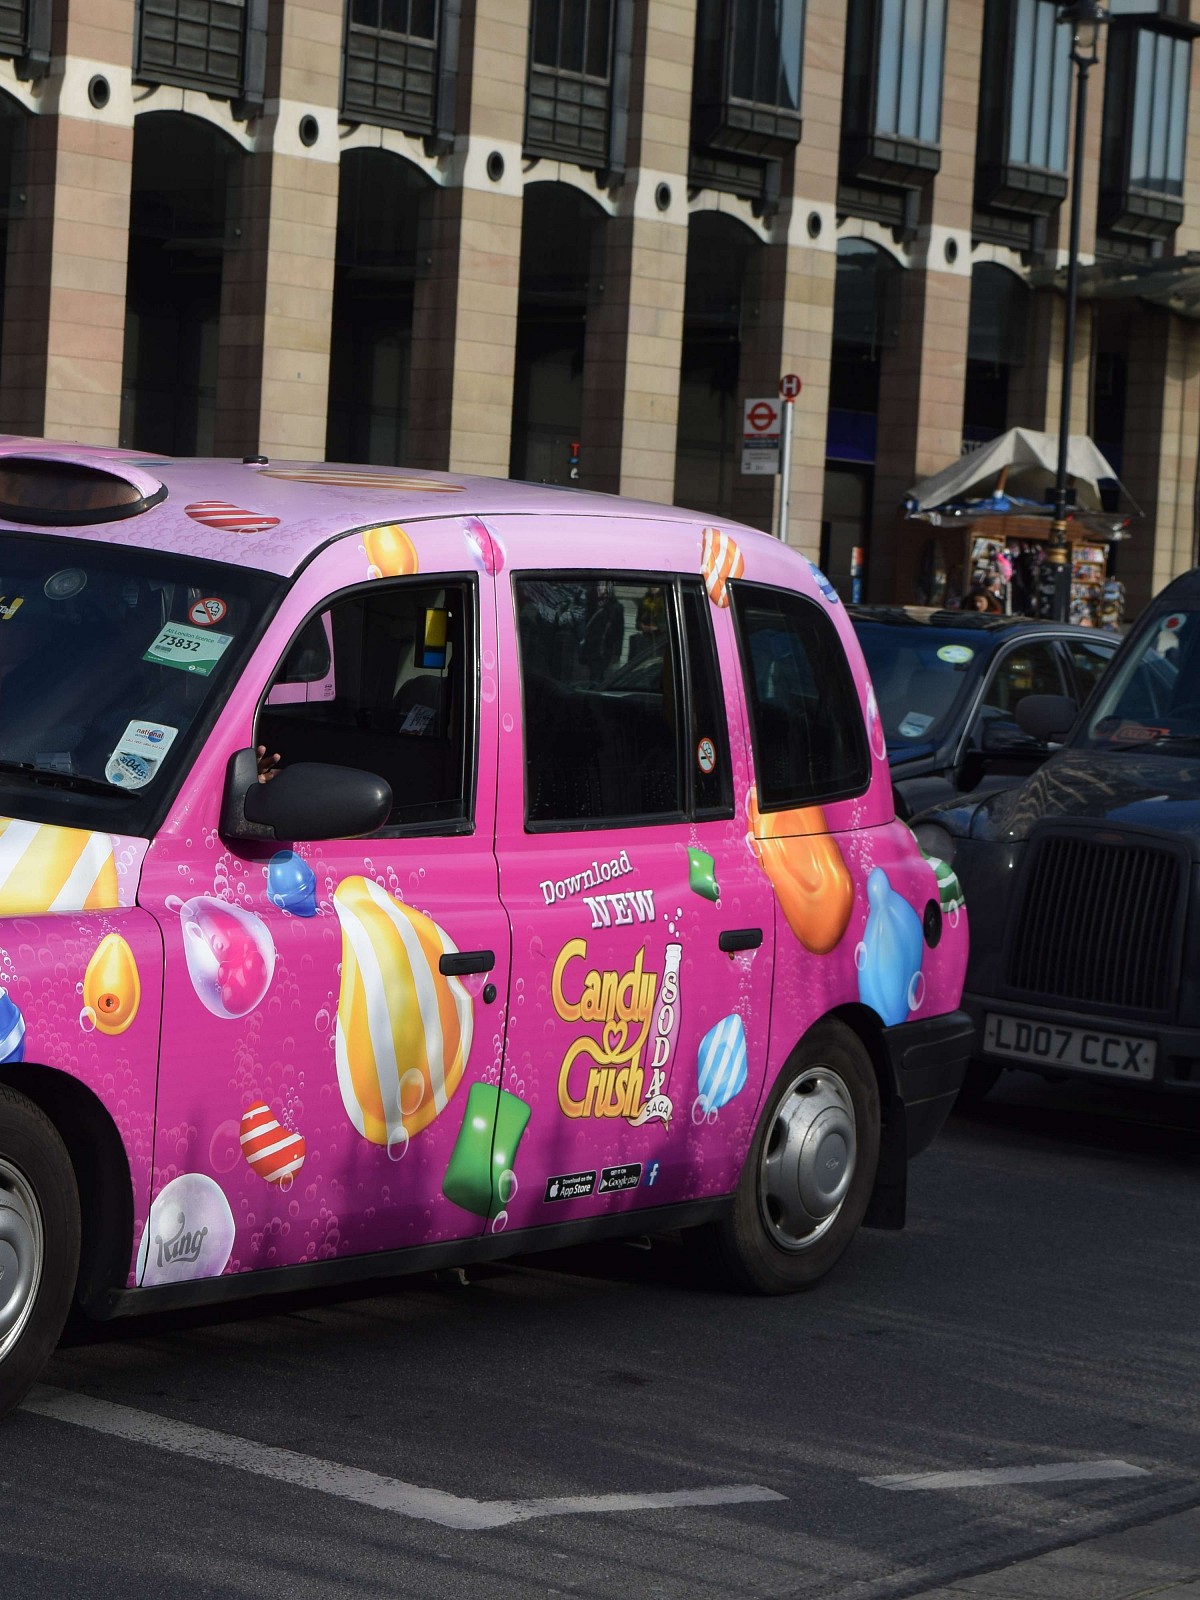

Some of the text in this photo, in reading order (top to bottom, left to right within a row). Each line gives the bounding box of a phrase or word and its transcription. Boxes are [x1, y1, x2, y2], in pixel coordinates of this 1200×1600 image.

[783, 377, 797, 395] H
[159, 634, 201, 652] 73832
[174, 629, 195, 639] London
[194, 633, 215, 643] licence
[136, 728, 165, 739] national
[540, 850, 634, 905] Download
[583, 890, 656, 929] NEW
[551, 938, 657, 1040] Candy
[645, 971, 677, 1100] SODA
[995, 1019, 1143, 1072] LD07 CCX
[557, 1036, 647, 1119] Crush
[645, 1098, 670, 1118] SAGA
[560, 1183, 591, 1198] App Store
[608, 1175, 640, 1188] Google play
[155, 1211, 209, 1268] King
